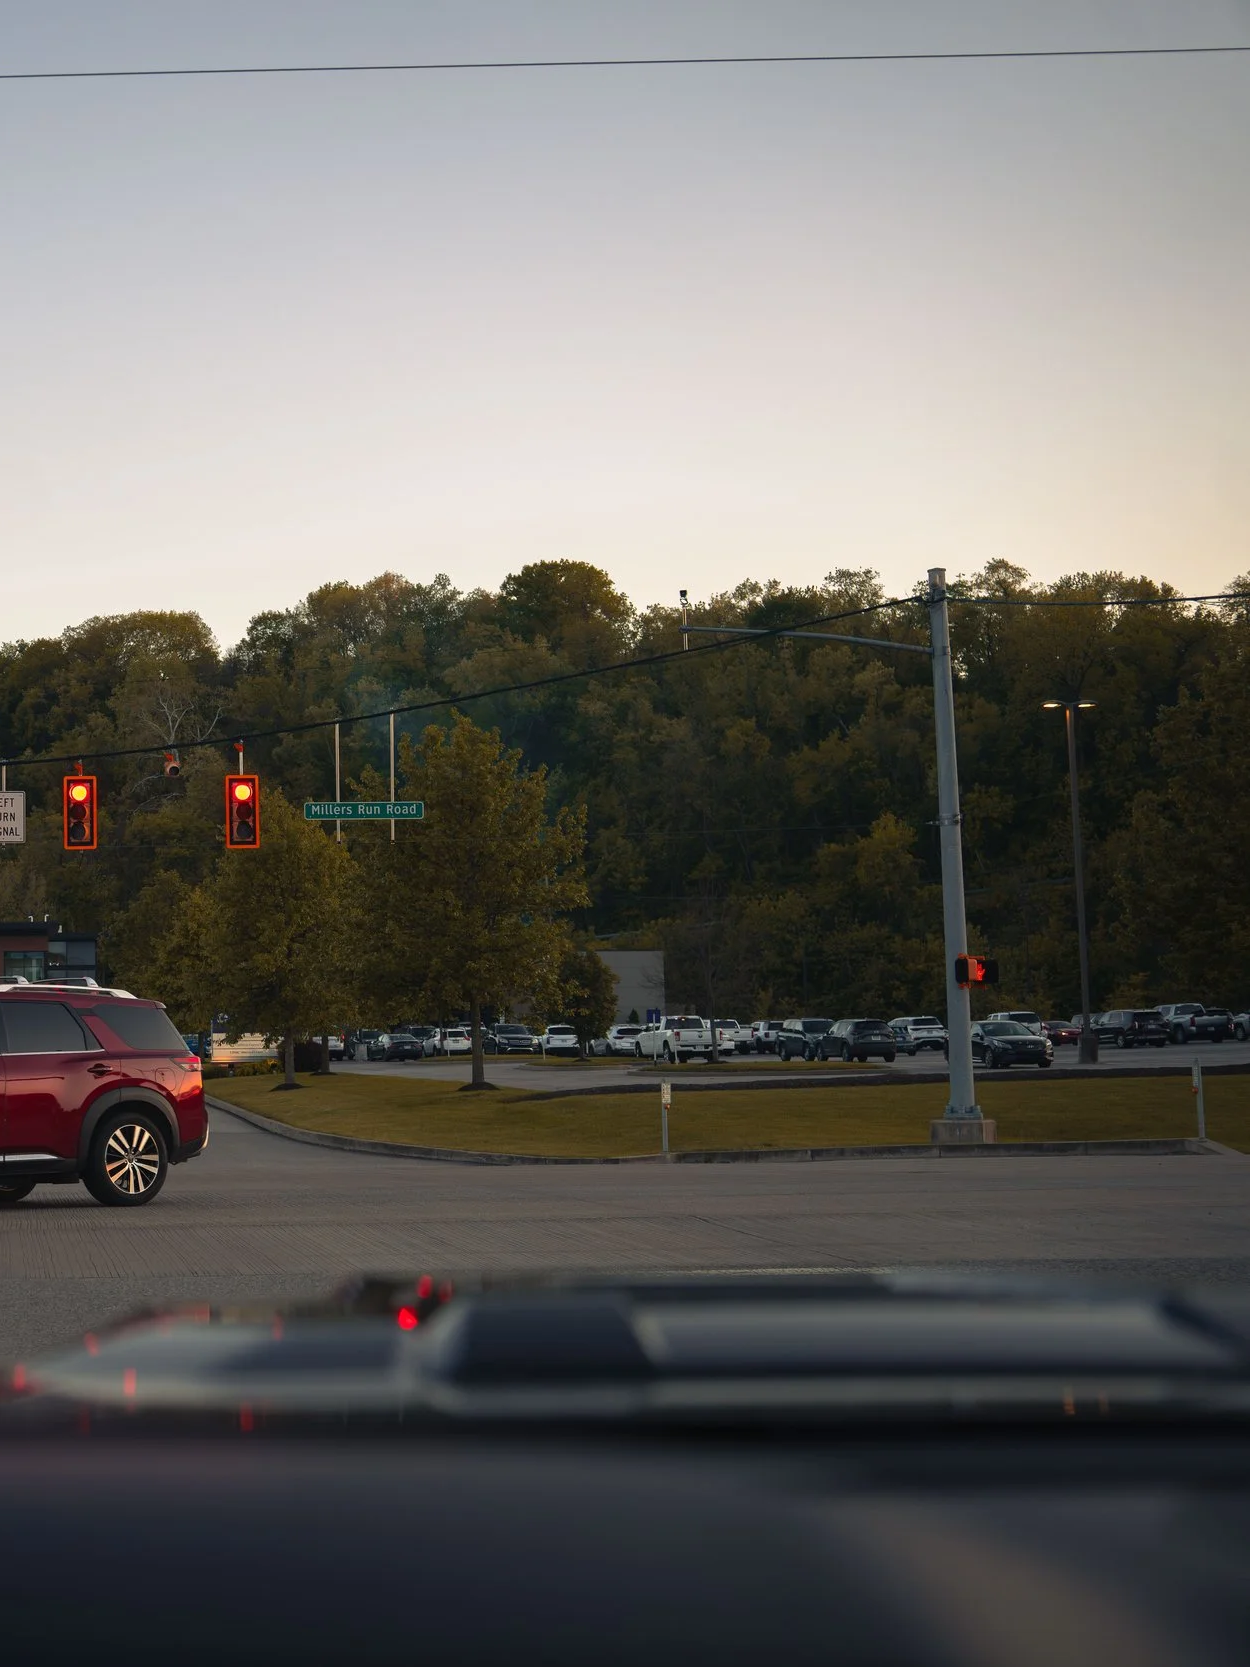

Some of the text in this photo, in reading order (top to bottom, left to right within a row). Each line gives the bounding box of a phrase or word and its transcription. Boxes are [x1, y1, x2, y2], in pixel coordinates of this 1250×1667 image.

[311, 803, 417, 815] Millers Run Road
